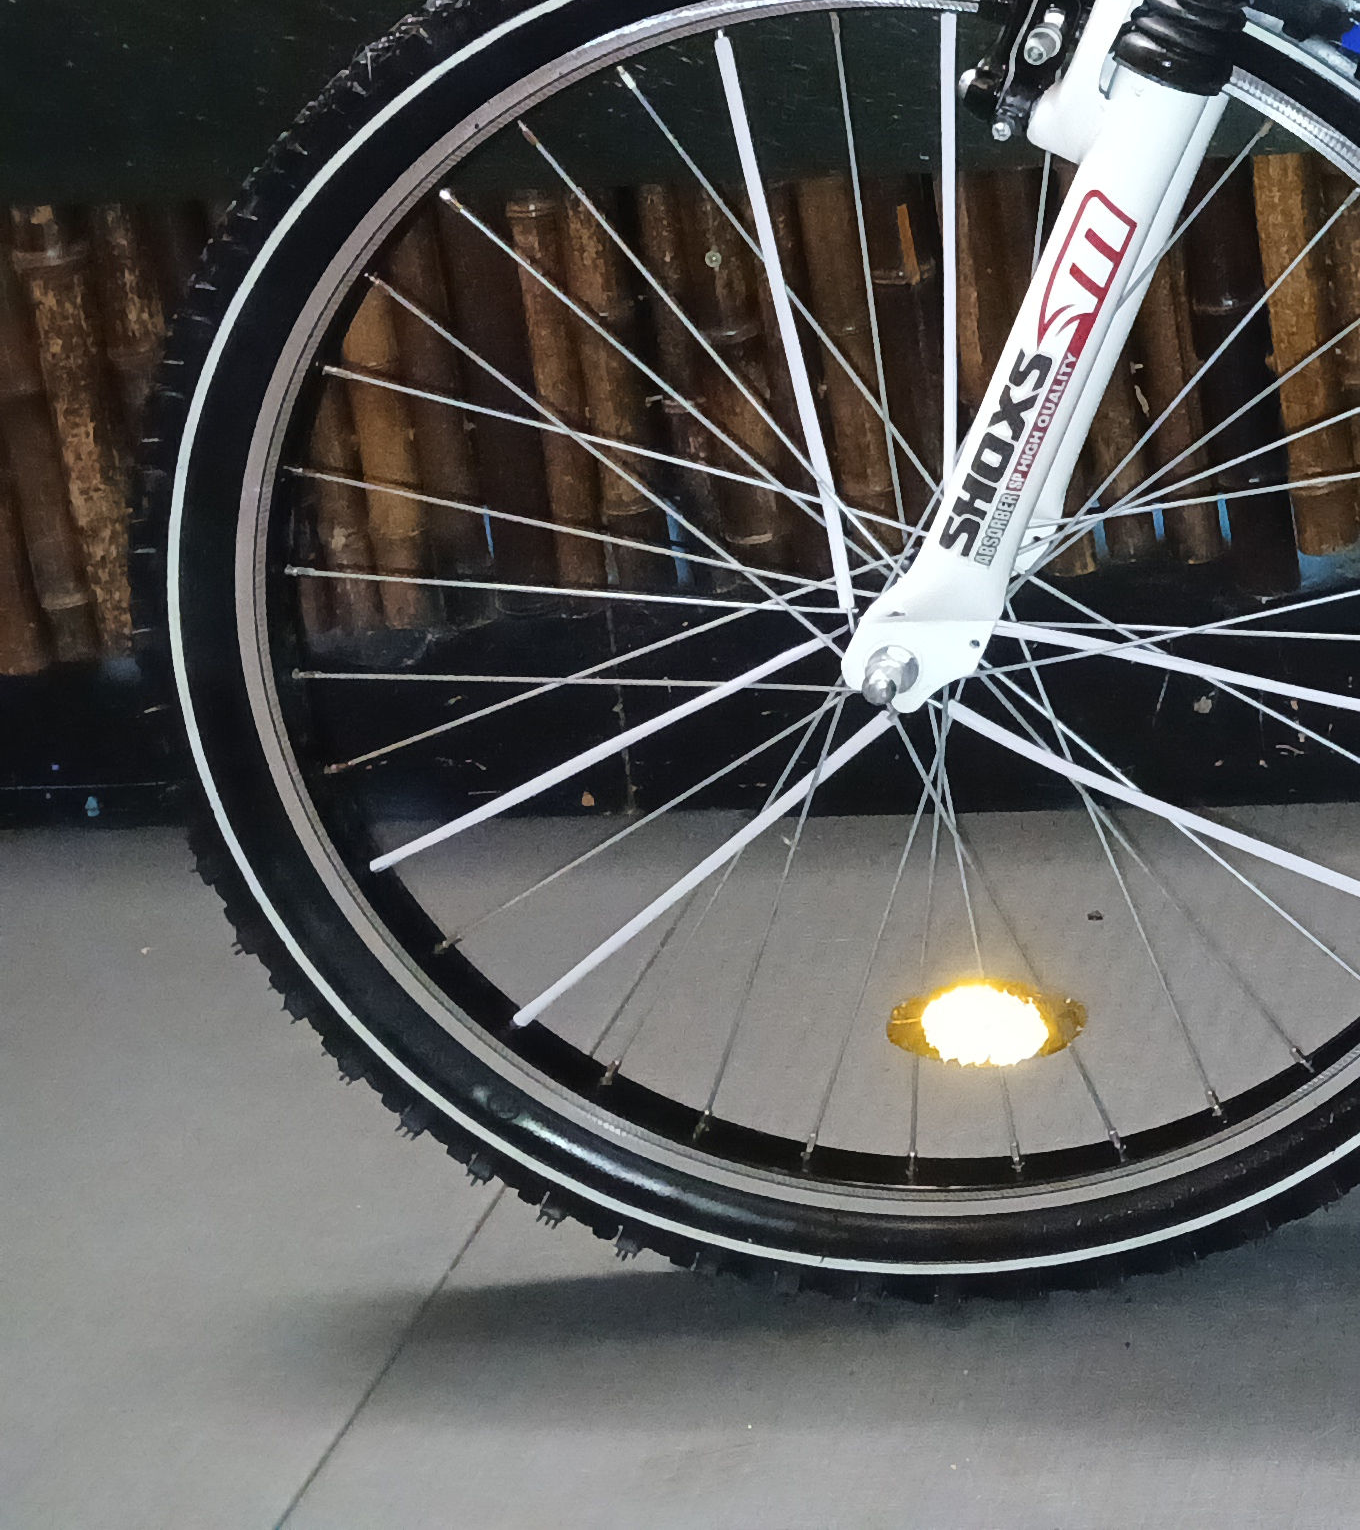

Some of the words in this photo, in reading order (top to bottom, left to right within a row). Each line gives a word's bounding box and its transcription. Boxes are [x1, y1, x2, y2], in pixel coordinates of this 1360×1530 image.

[938, 347, 1053, 558] SHOXS
[973, 491, 1021, 567] ABSORBER
[1016, 431, 1040, 473] HIGH
[1037, 352, 1078, 429] QUALITY
